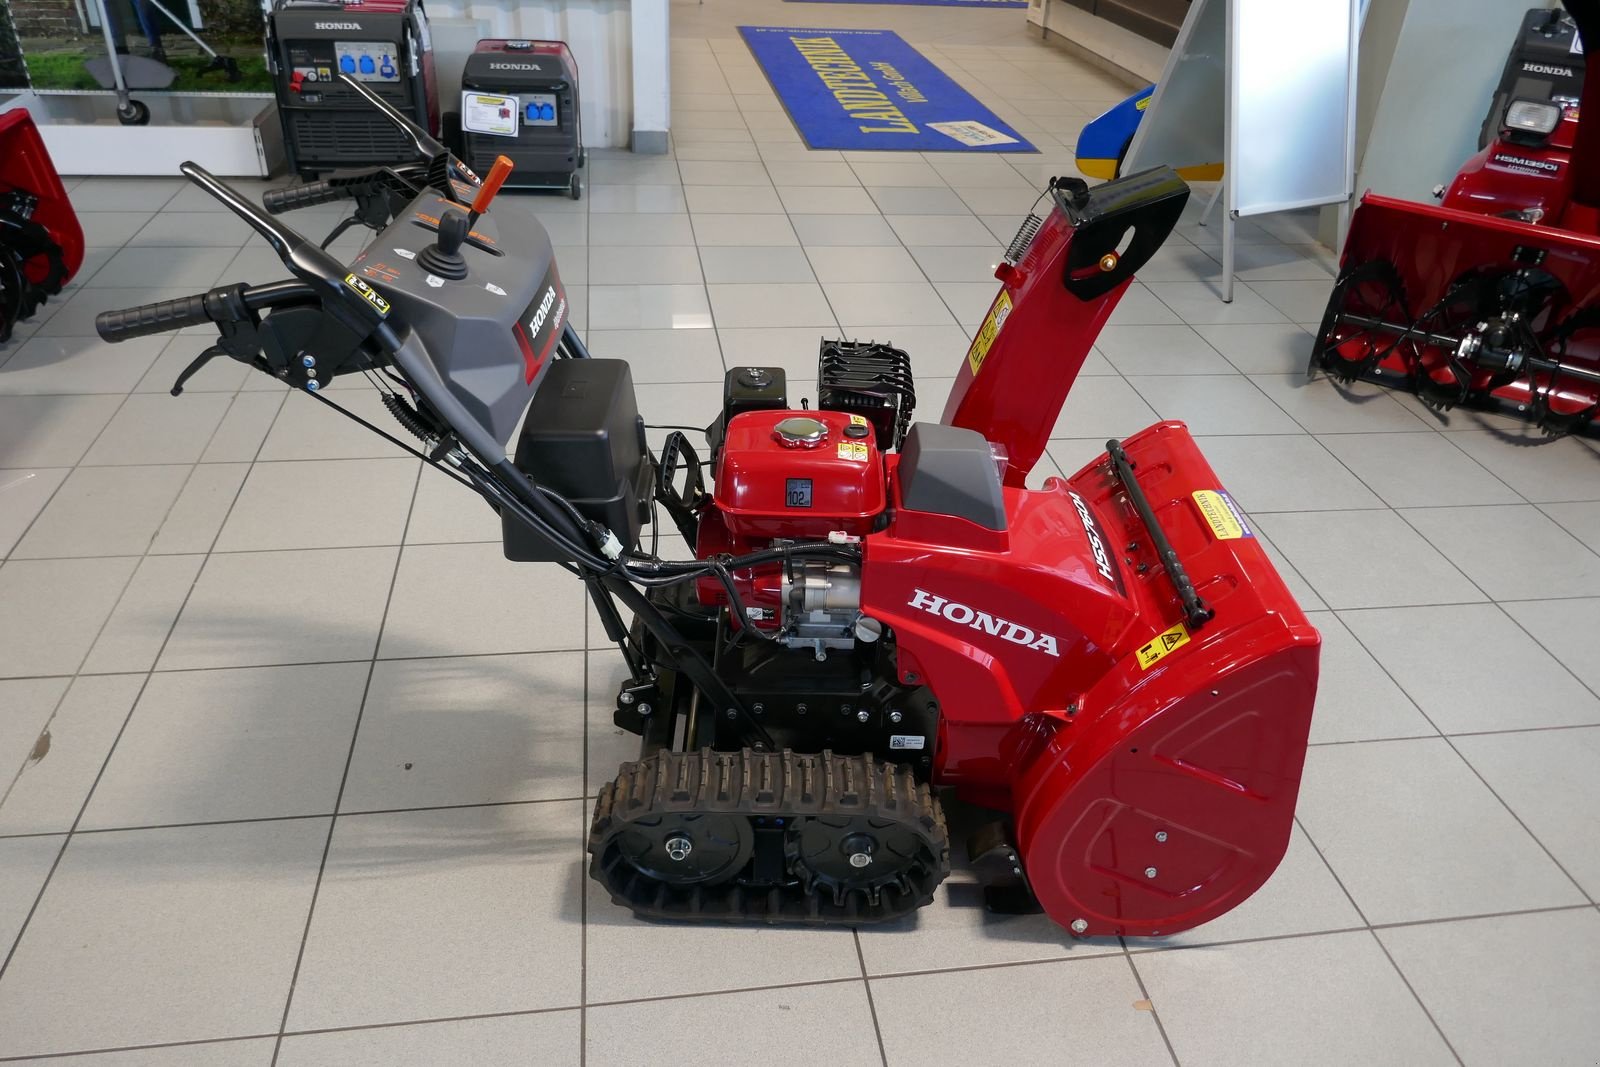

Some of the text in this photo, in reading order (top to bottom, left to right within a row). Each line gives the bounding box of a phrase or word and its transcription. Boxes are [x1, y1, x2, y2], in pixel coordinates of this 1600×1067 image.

[314, 22, 362, 30] HONDA
[490, 63, 541, 71] HONDA
[789, 36, 920, 134] LANDTECHNIK
[1522, 63, 1573, 77] HONDA
[529, 285, 556, 339] HONDA
[788, 491, 804, 505] 102
[1195, 493, 1229, 537] LANDTECHNIK
[1068, 491, 1114, 581] HSS760A
[907, 588, 1060, 657] HONDA
